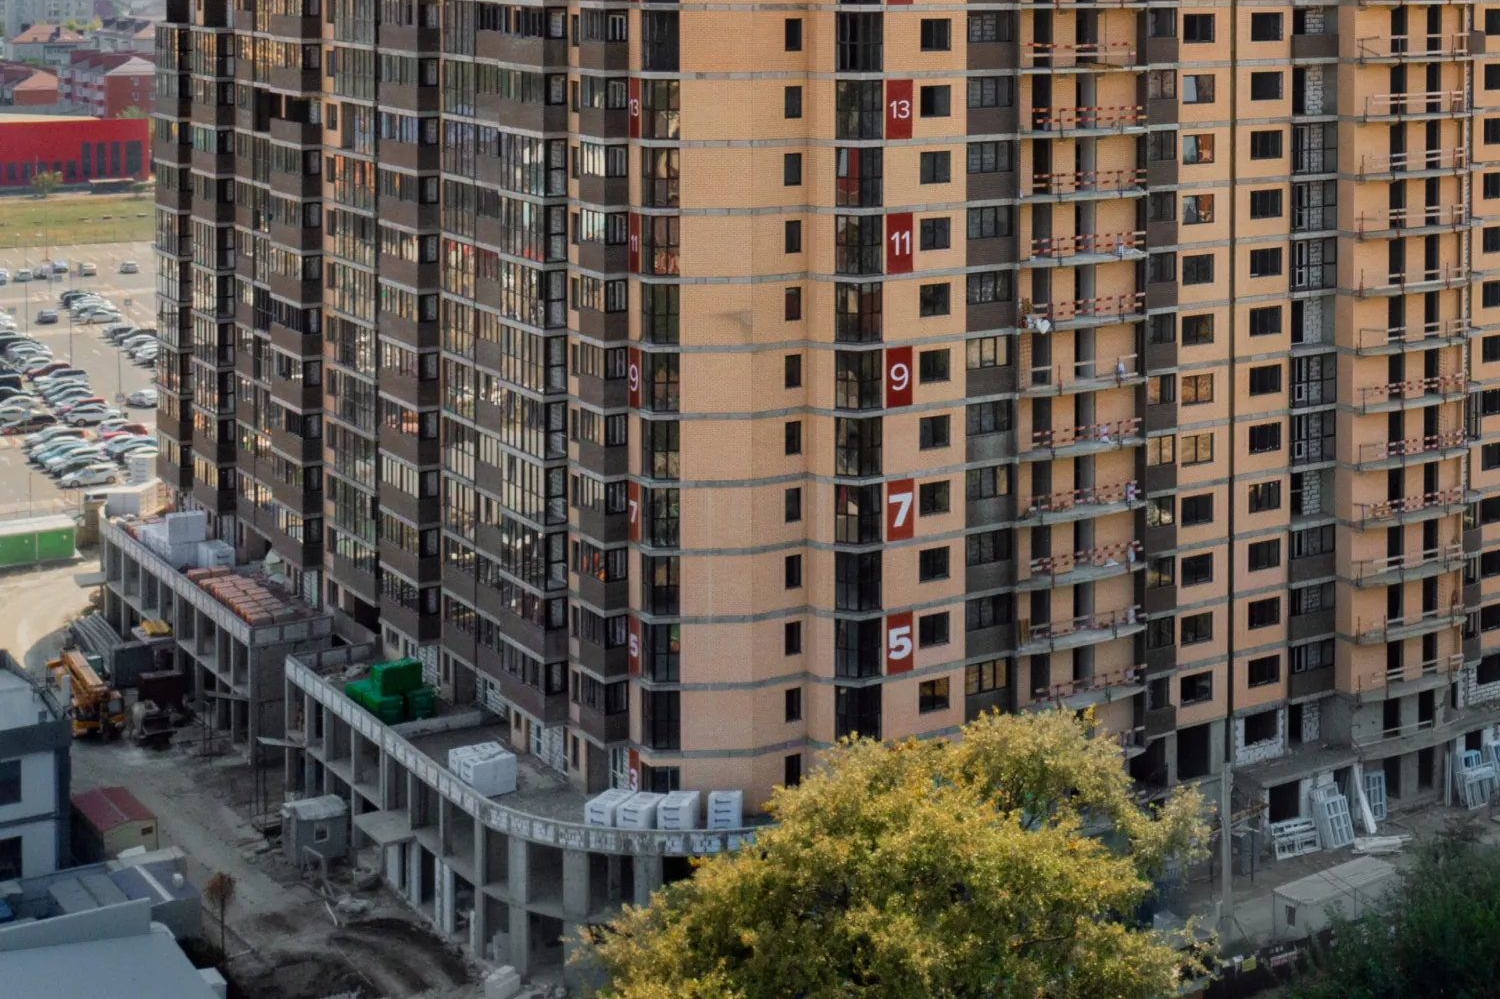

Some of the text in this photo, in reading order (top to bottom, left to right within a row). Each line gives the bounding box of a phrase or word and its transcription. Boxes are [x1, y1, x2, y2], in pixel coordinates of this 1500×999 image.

[629, 98, 640, 117] 13
[889, 99, 910, 119] 13
[890, 230, 910, 255] 11
[629, 363, 639, 392] 9
[890, 362, 910, 391] 9
[629, 499, 638, 524] 7
[888, 492, 914, 528] 7
[629, 633, 639, 658] 5
[888, 625, 913, 660] 5
